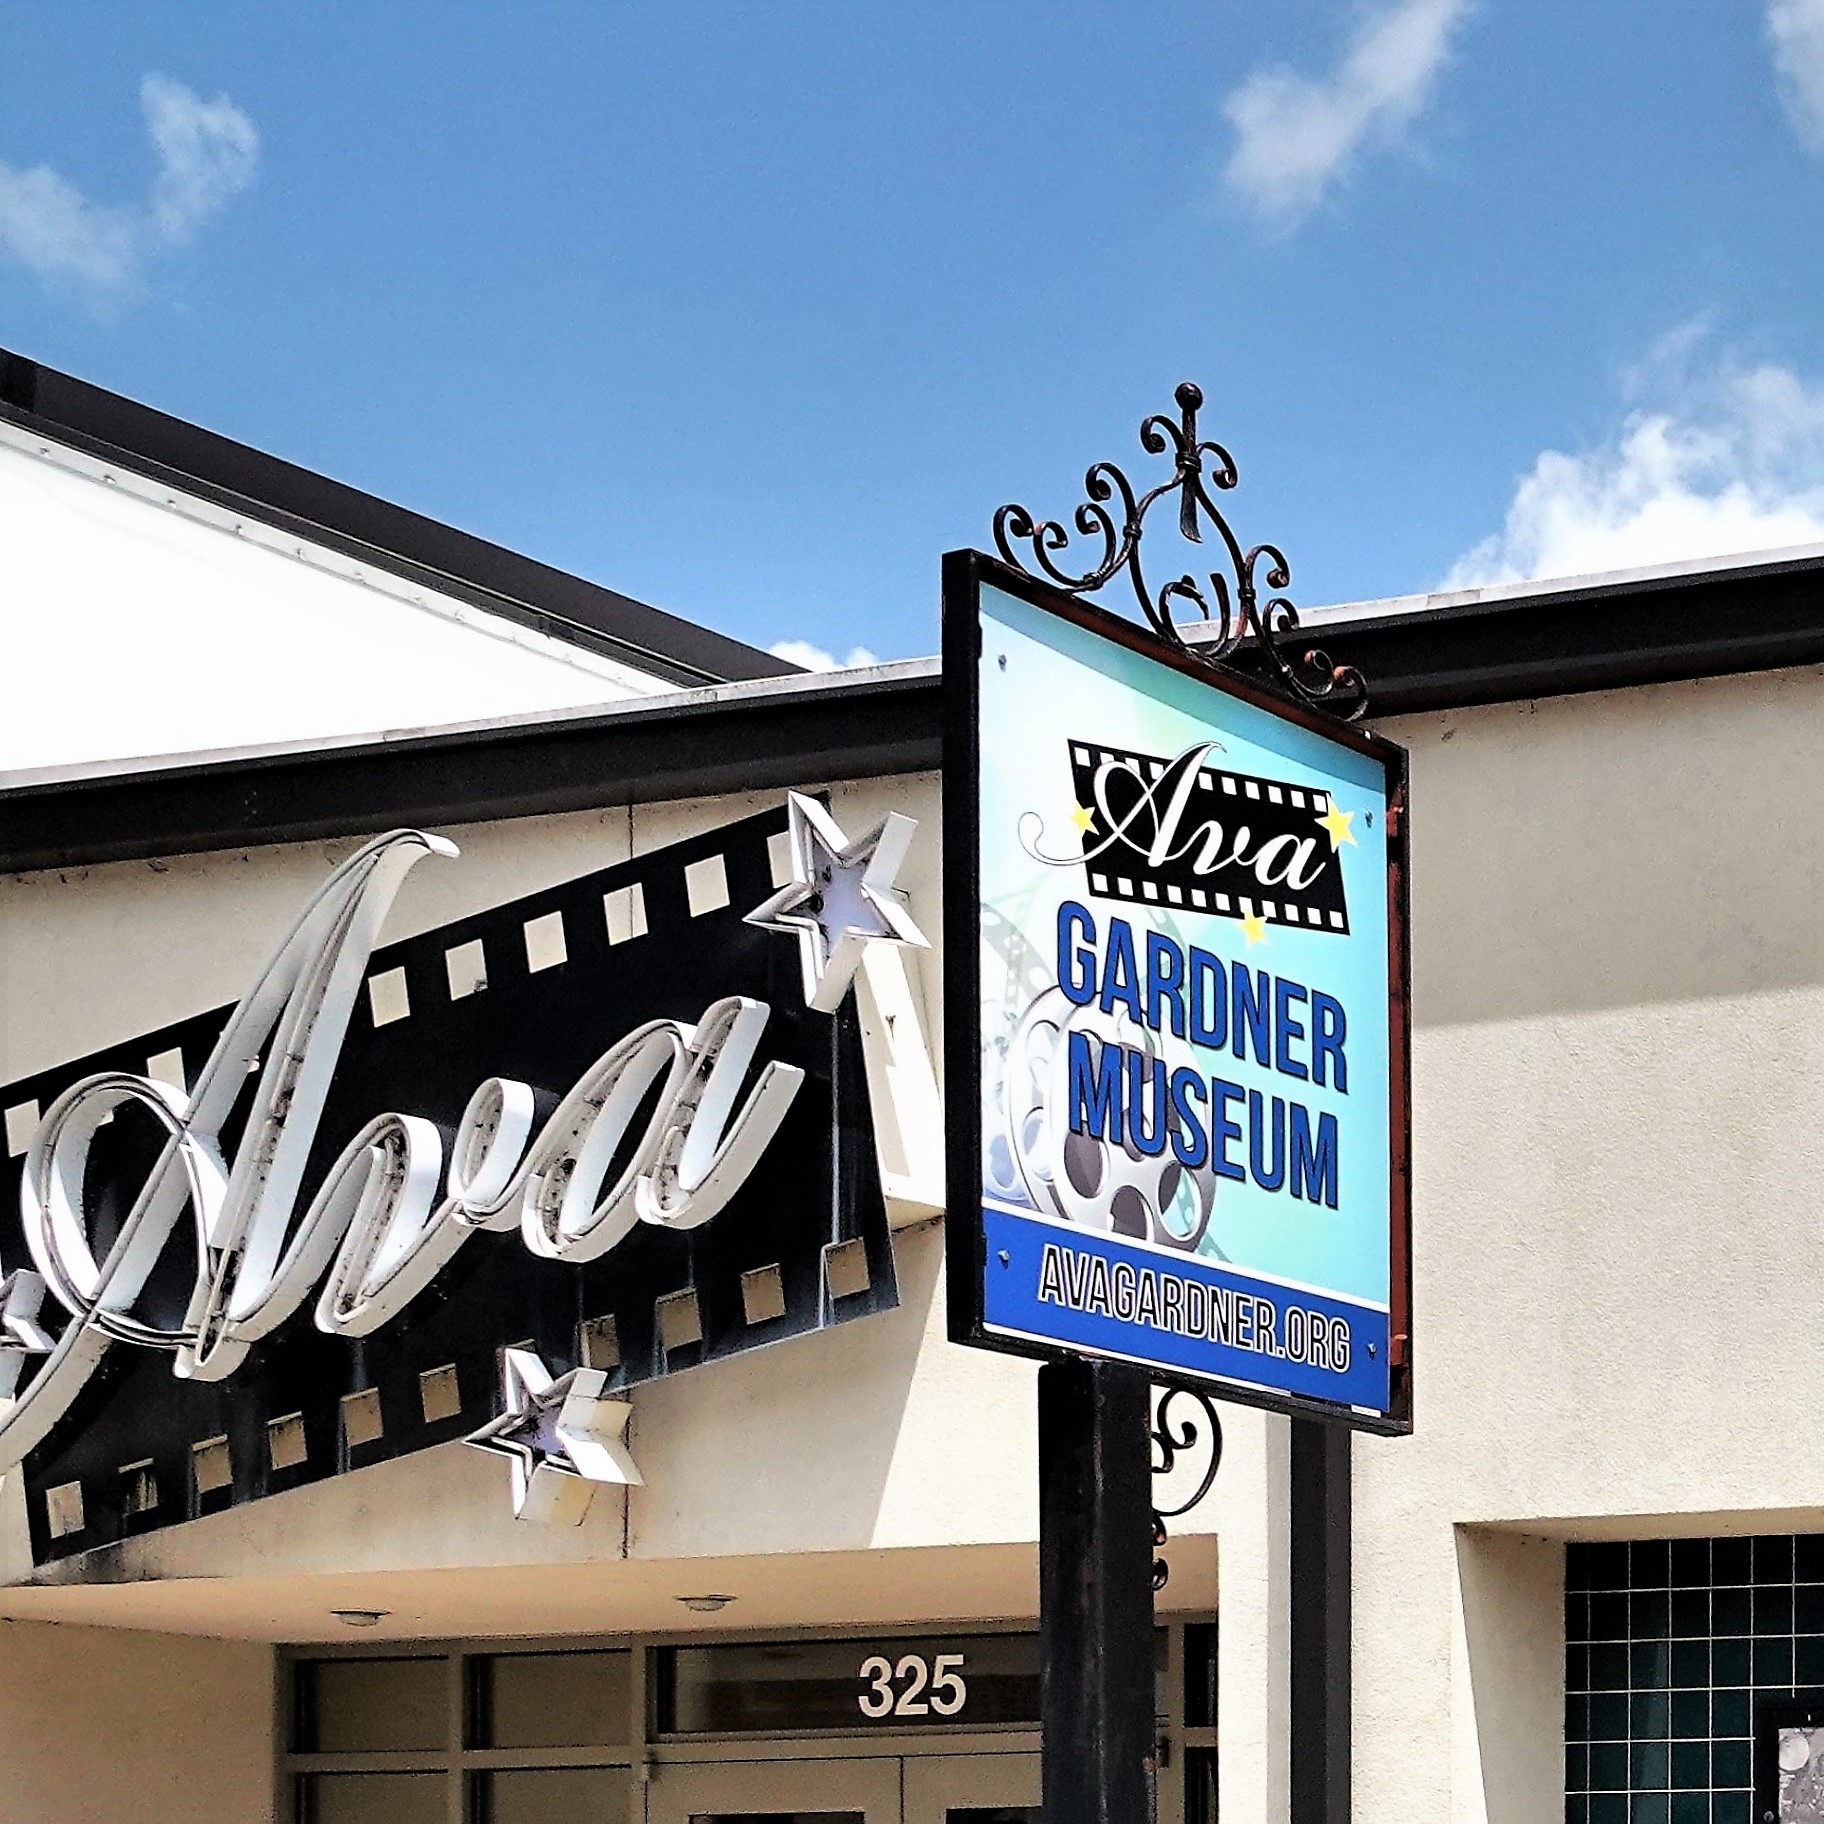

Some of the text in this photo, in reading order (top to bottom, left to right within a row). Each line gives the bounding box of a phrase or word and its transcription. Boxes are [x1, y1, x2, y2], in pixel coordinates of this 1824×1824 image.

[1017, 740, 1326, 890] Ava
[1056, 900, 1349, 1095] GARDNER
[0, 829, 805, 1475] Ava
[1068, 1030, 1339, 1210] MUSEUM
[1038, 1243, 1351, 1374] AVAGARDNER.ORG
[858, 1653, 967, 1718] 325
